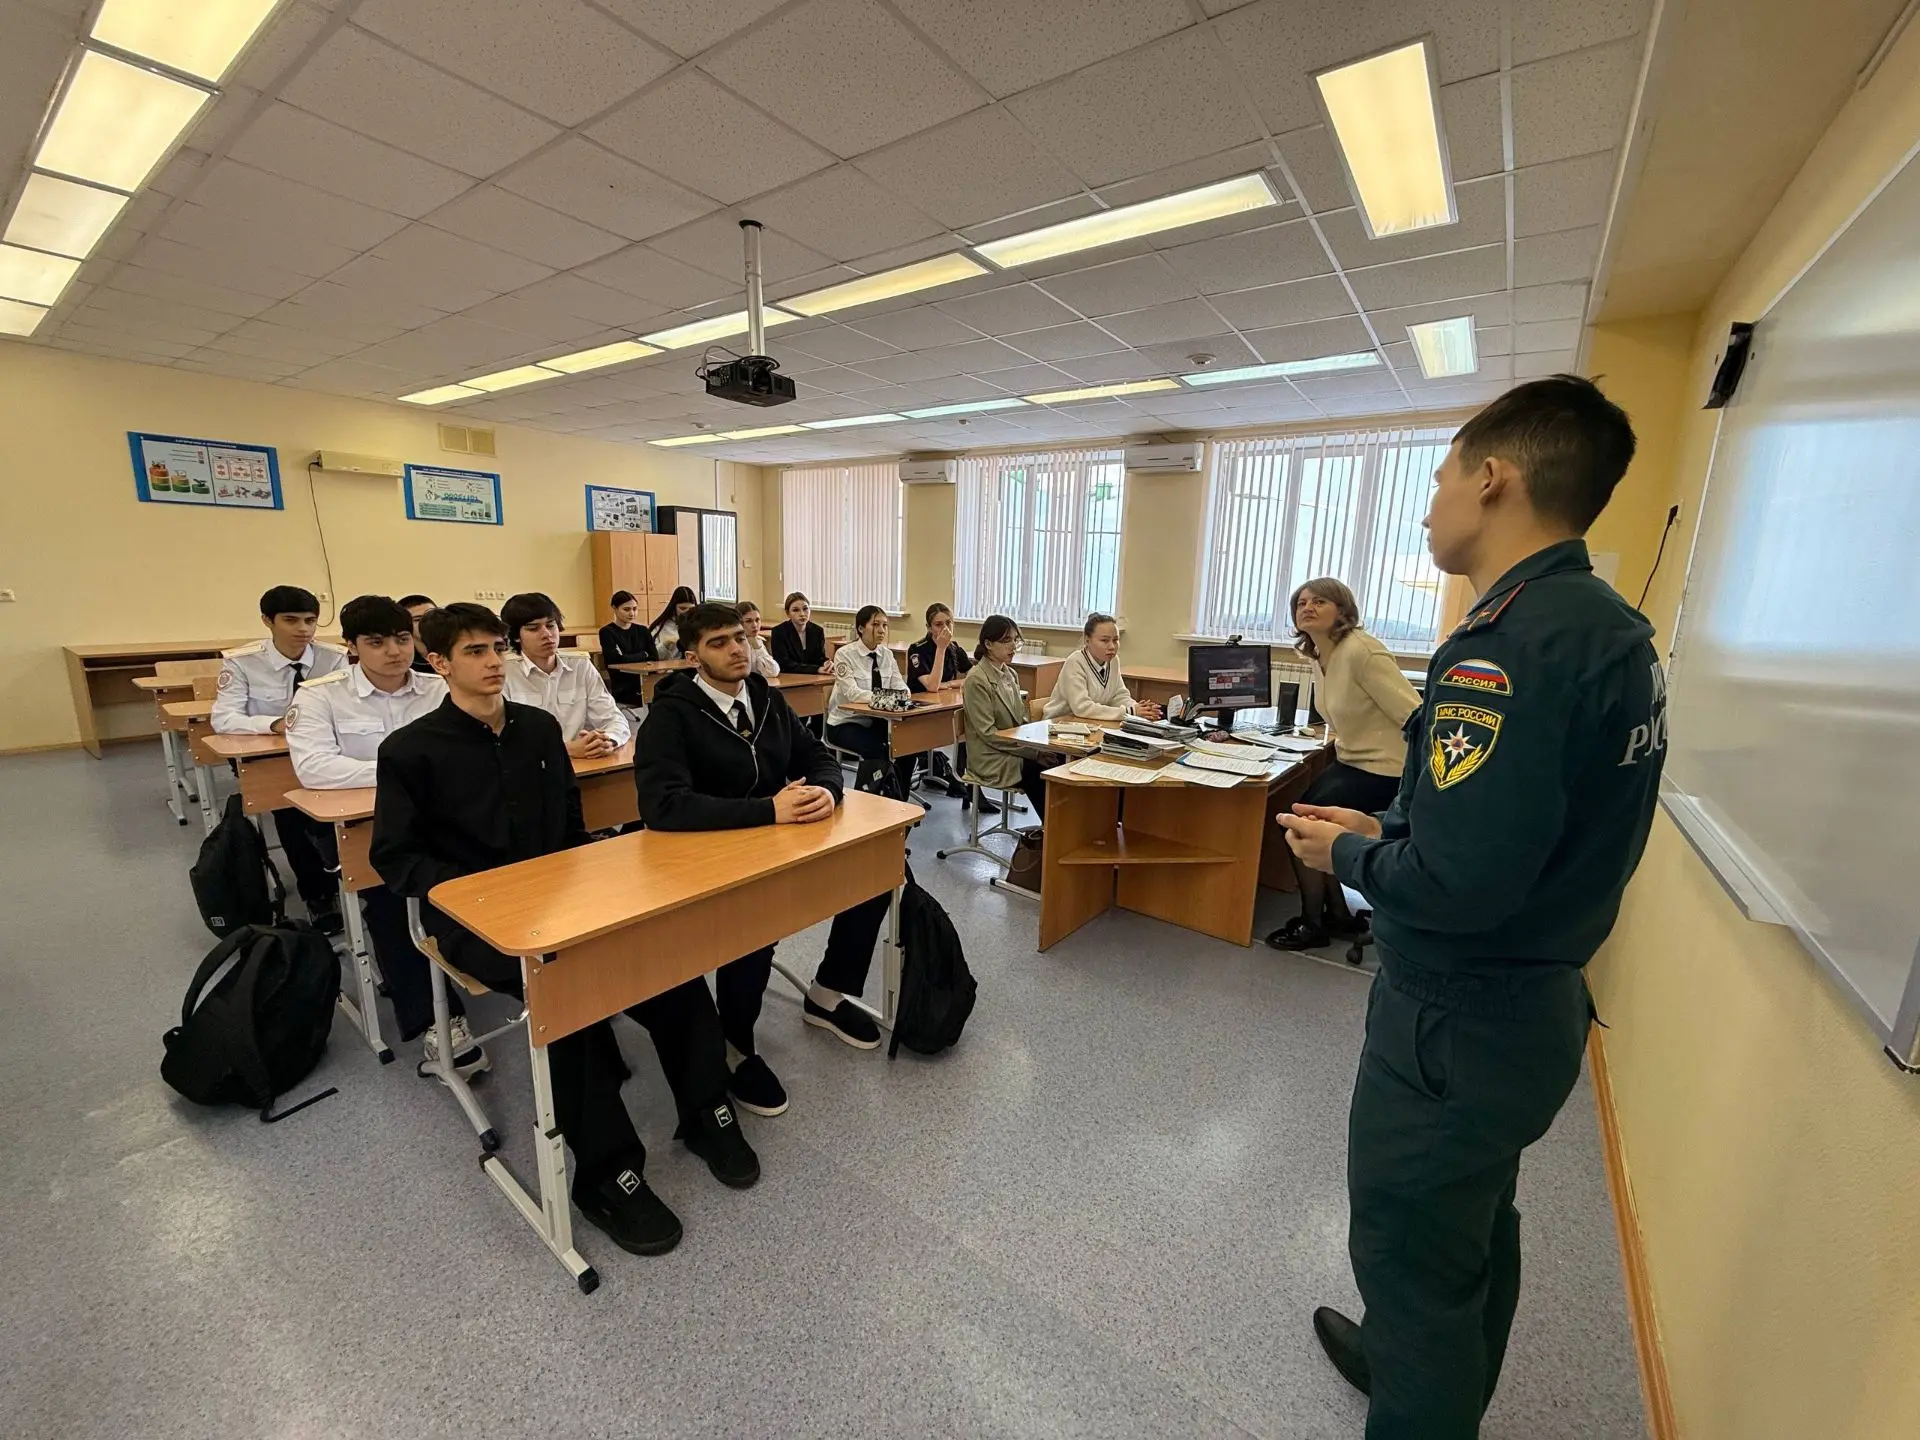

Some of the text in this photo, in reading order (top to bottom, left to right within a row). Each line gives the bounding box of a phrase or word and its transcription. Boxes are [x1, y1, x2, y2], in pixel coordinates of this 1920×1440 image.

[1451, 675, 1497, 689] РОССИЯ
[1439, 707, 1497, 727] МЧС РОССИИ
